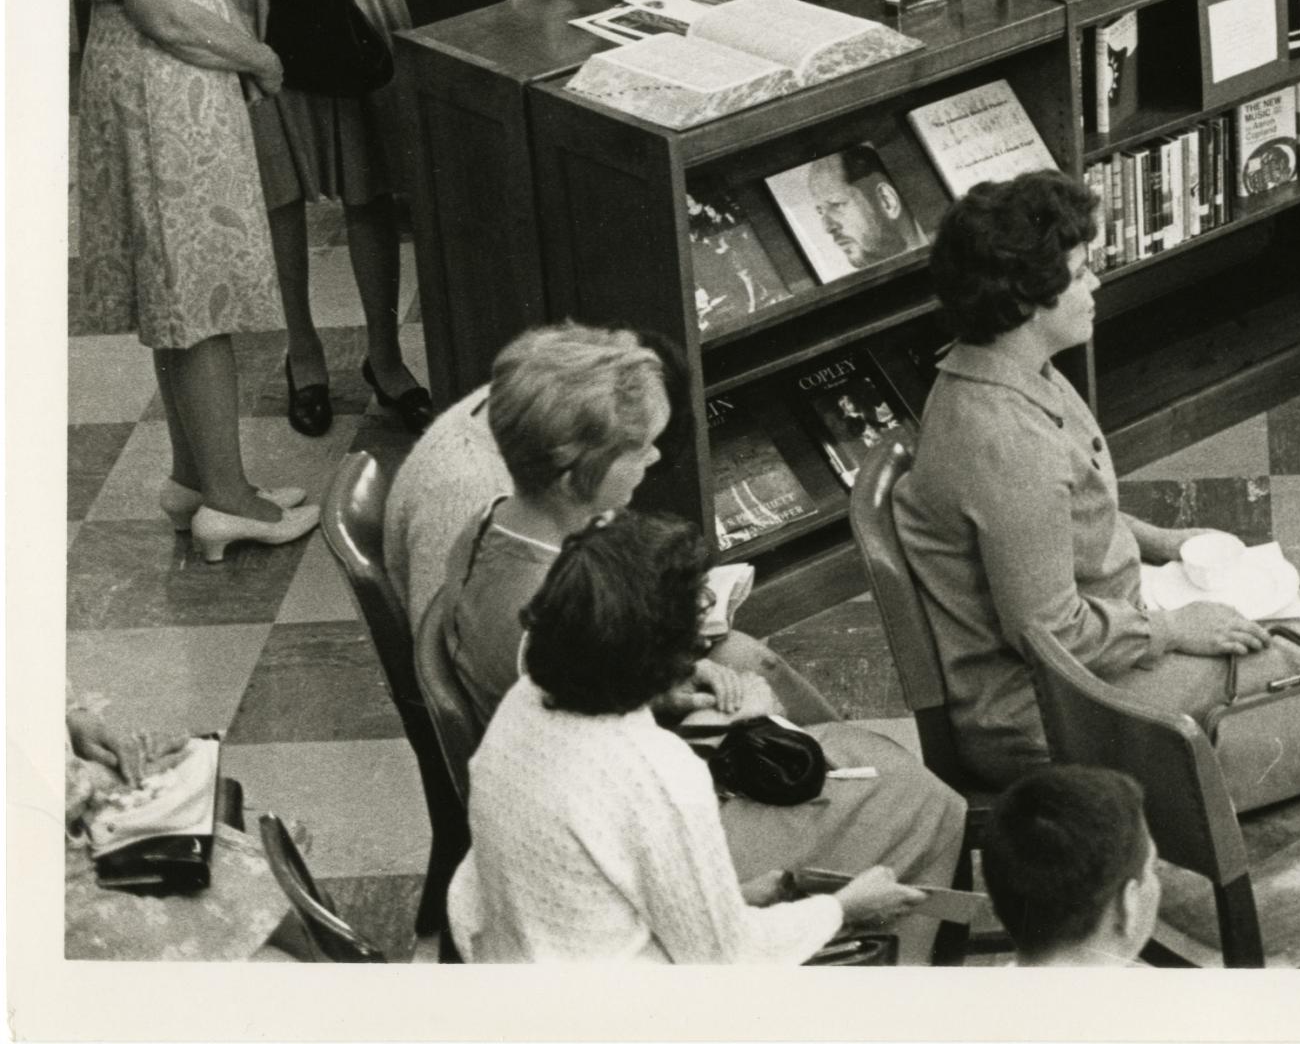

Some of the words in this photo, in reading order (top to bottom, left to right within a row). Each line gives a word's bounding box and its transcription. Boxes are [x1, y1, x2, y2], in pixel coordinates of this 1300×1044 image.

[1244, 101, 1261, 113] THE
[1263, 95, 1282, 107] NEW
[1244, 108, 1271, 123] MUSIC
[798, 358, 857, 391] COPLEY
